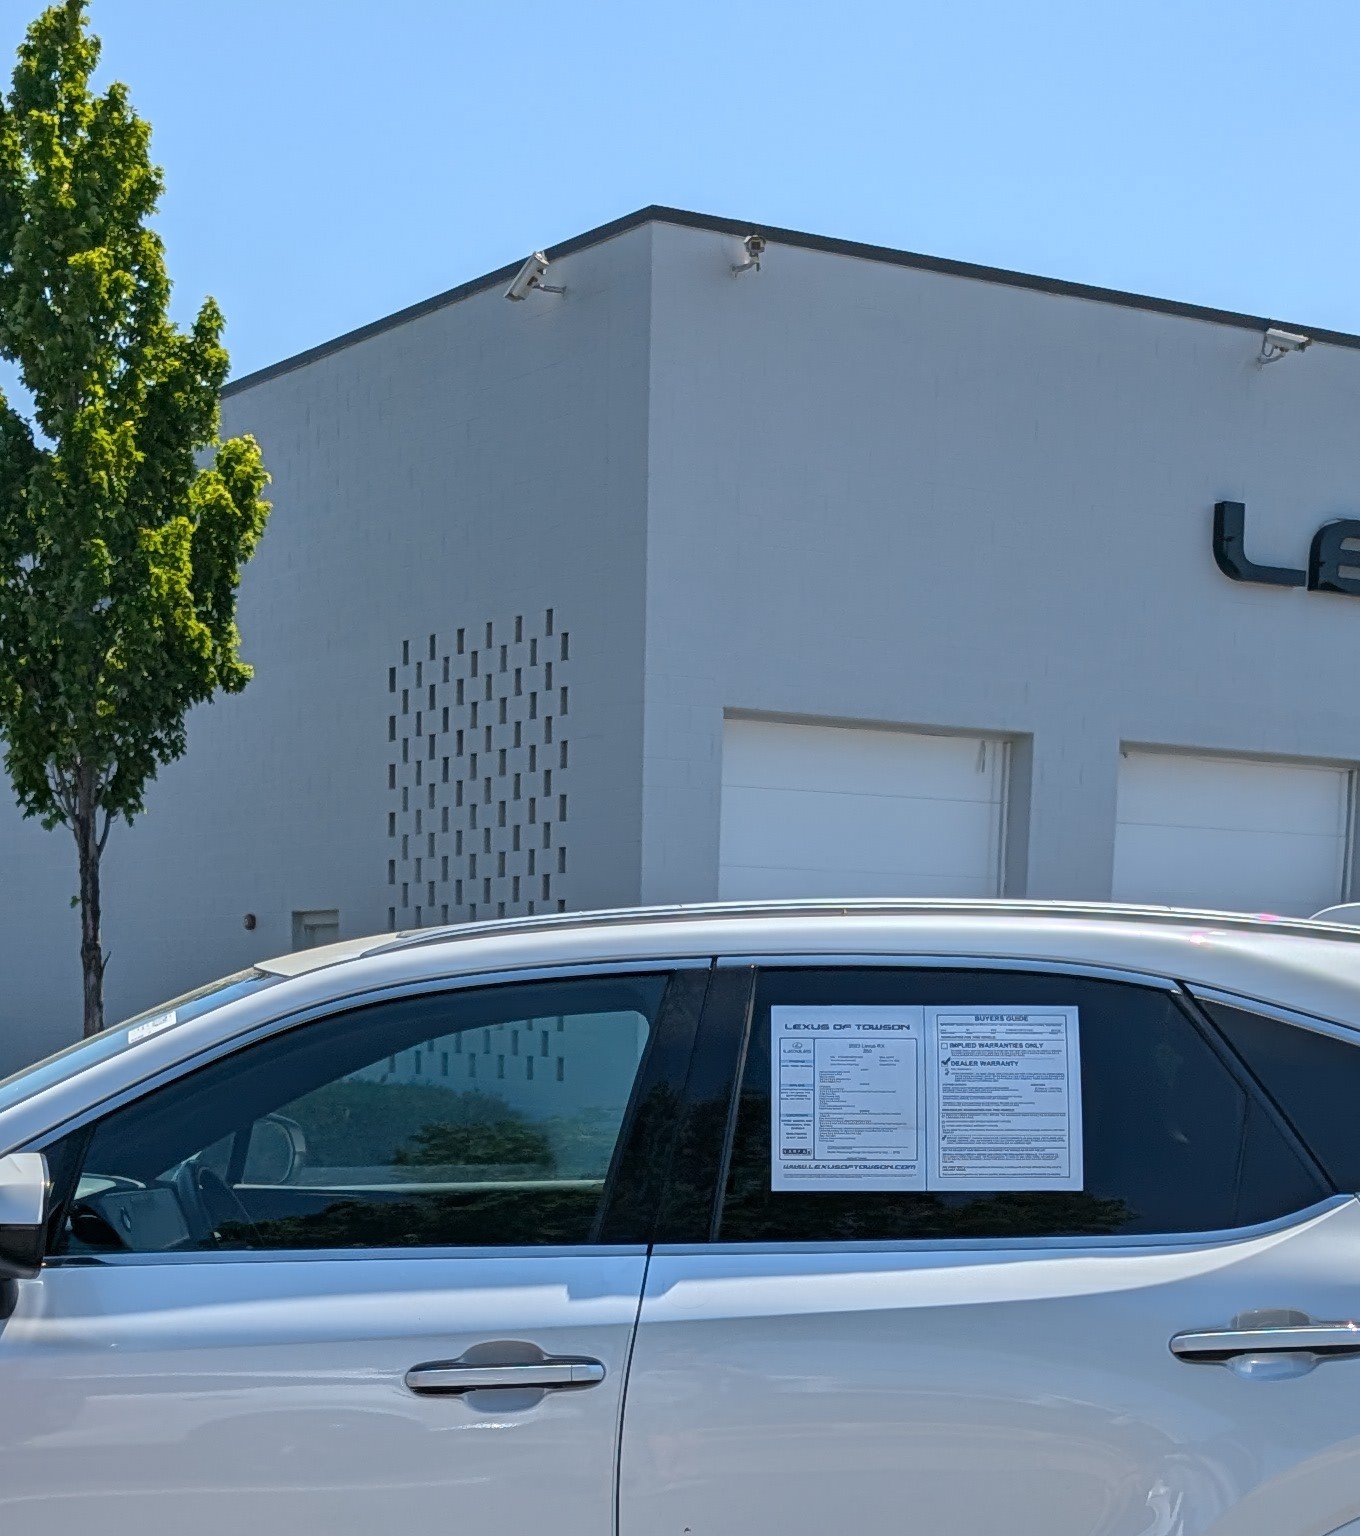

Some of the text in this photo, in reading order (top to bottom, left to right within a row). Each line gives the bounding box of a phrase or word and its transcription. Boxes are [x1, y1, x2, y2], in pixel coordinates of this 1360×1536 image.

[974, 1014, 1029, 1022] BUYERS GUIDE
[784, 1023, 911, 1031] LEXUS OF TOWSON
